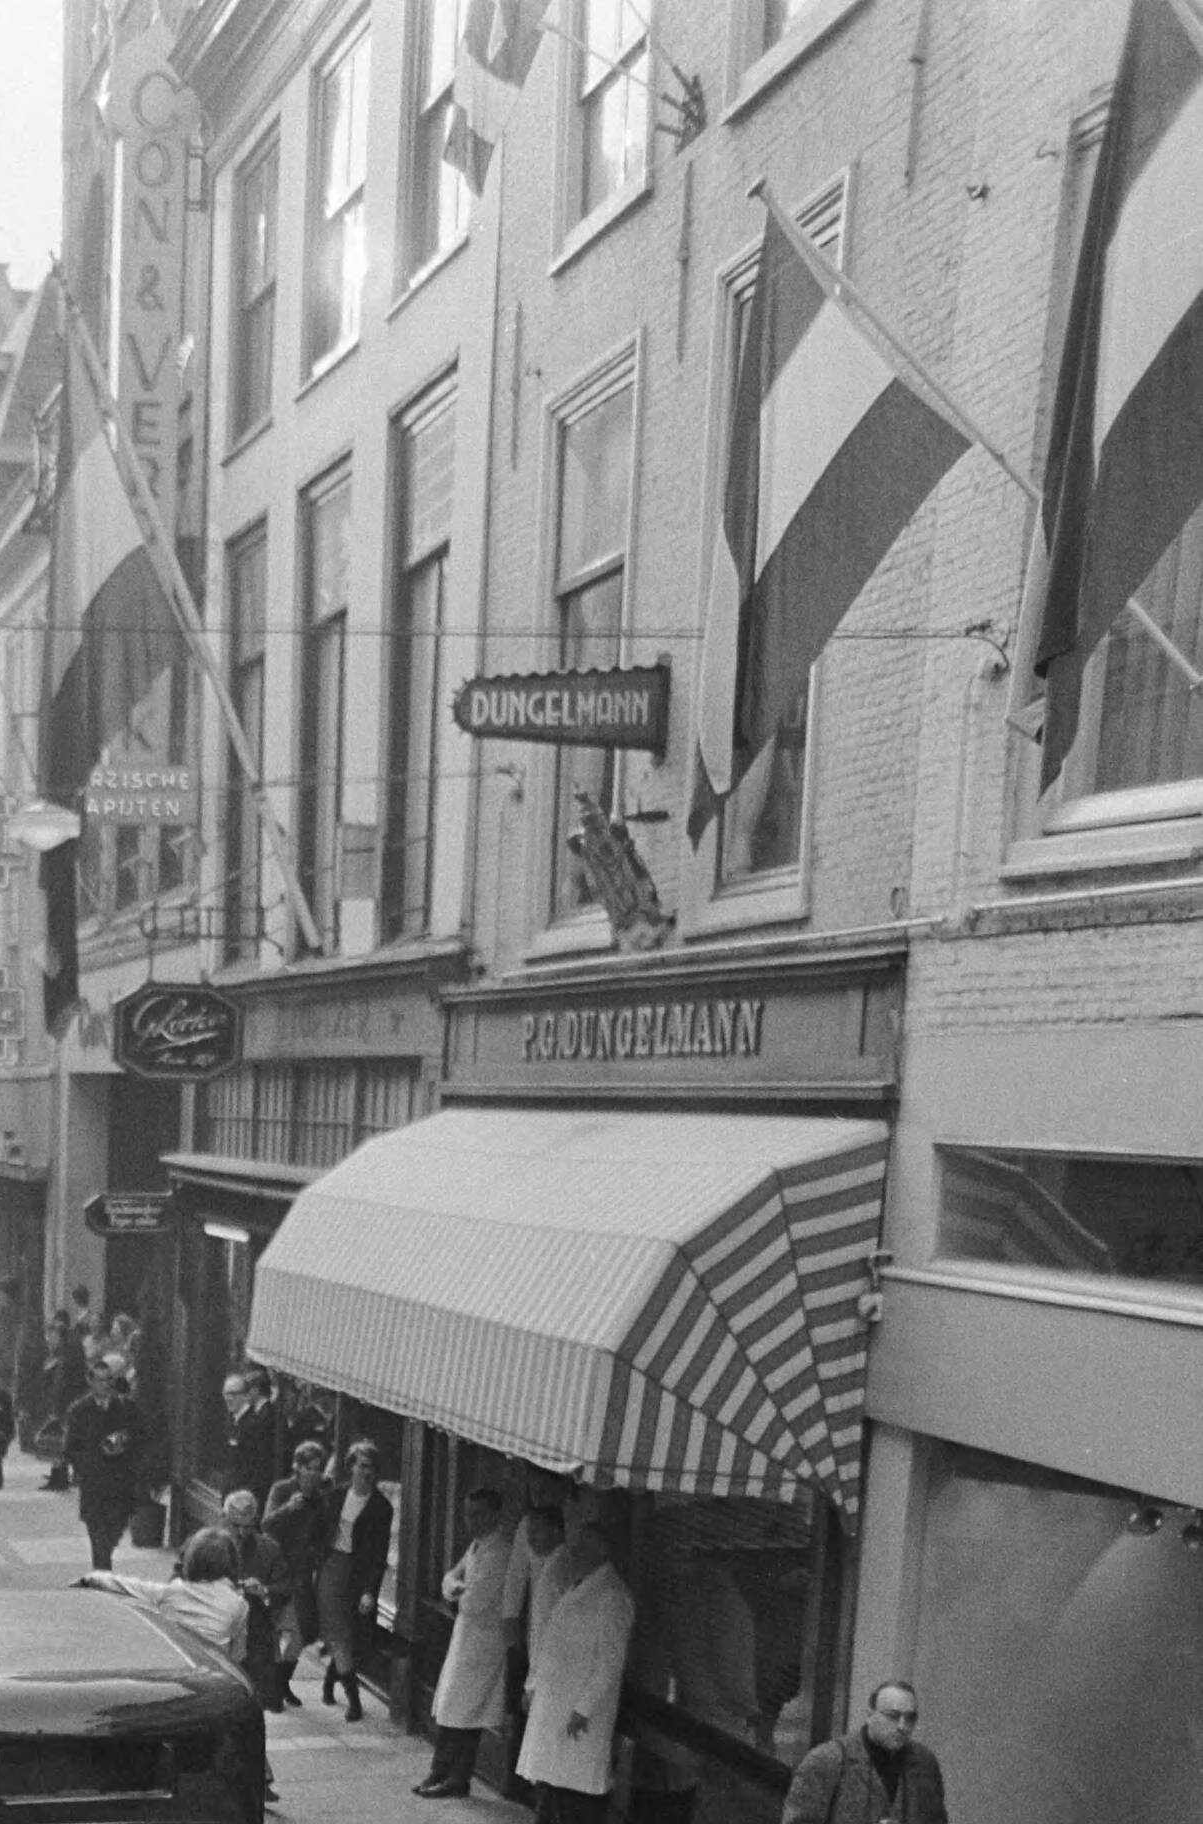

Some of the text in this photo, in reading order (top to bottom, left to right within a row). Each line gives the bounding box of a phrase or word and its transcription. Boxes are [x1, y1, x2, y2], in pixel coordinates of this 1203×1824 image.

[470, 690, 649, 727] DUNGELMANN
[90, 770, 190, 790] RZISCHE
[86, 798, 181, 817] APIJTEN
